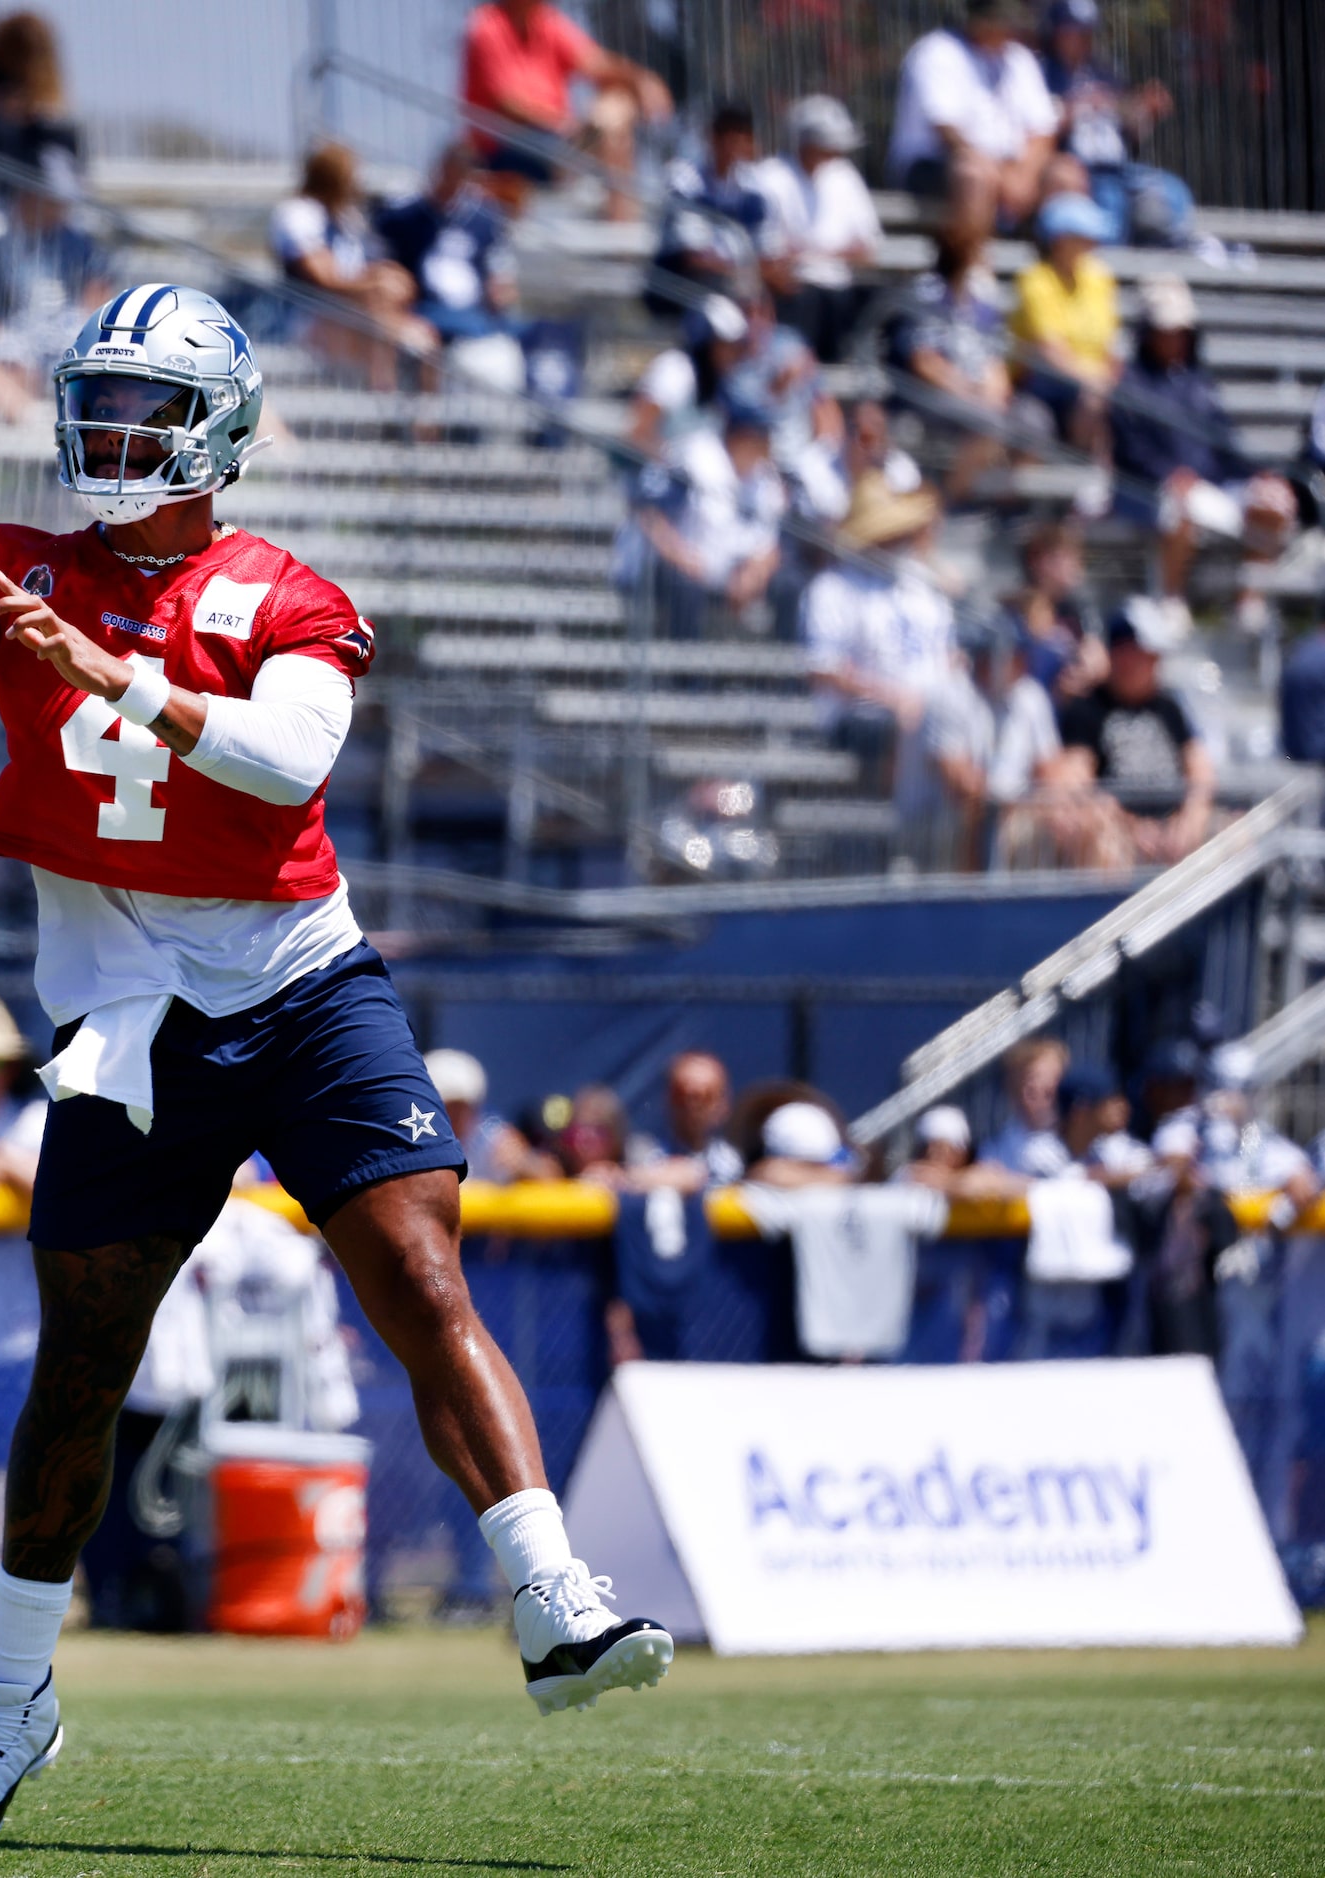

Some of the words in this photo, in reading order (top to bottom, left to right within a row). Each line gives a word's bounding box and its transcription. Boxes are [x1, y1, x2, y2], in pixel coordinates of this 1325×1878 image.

[95, 348, 135, 357] COWBOYS
[101, 612, 167, 640] COWBOYS
[206, 612, 245, 628] AT&T
[60, 654, 171, 842] 4
[742, 1443, 1155, 1556] Academy
